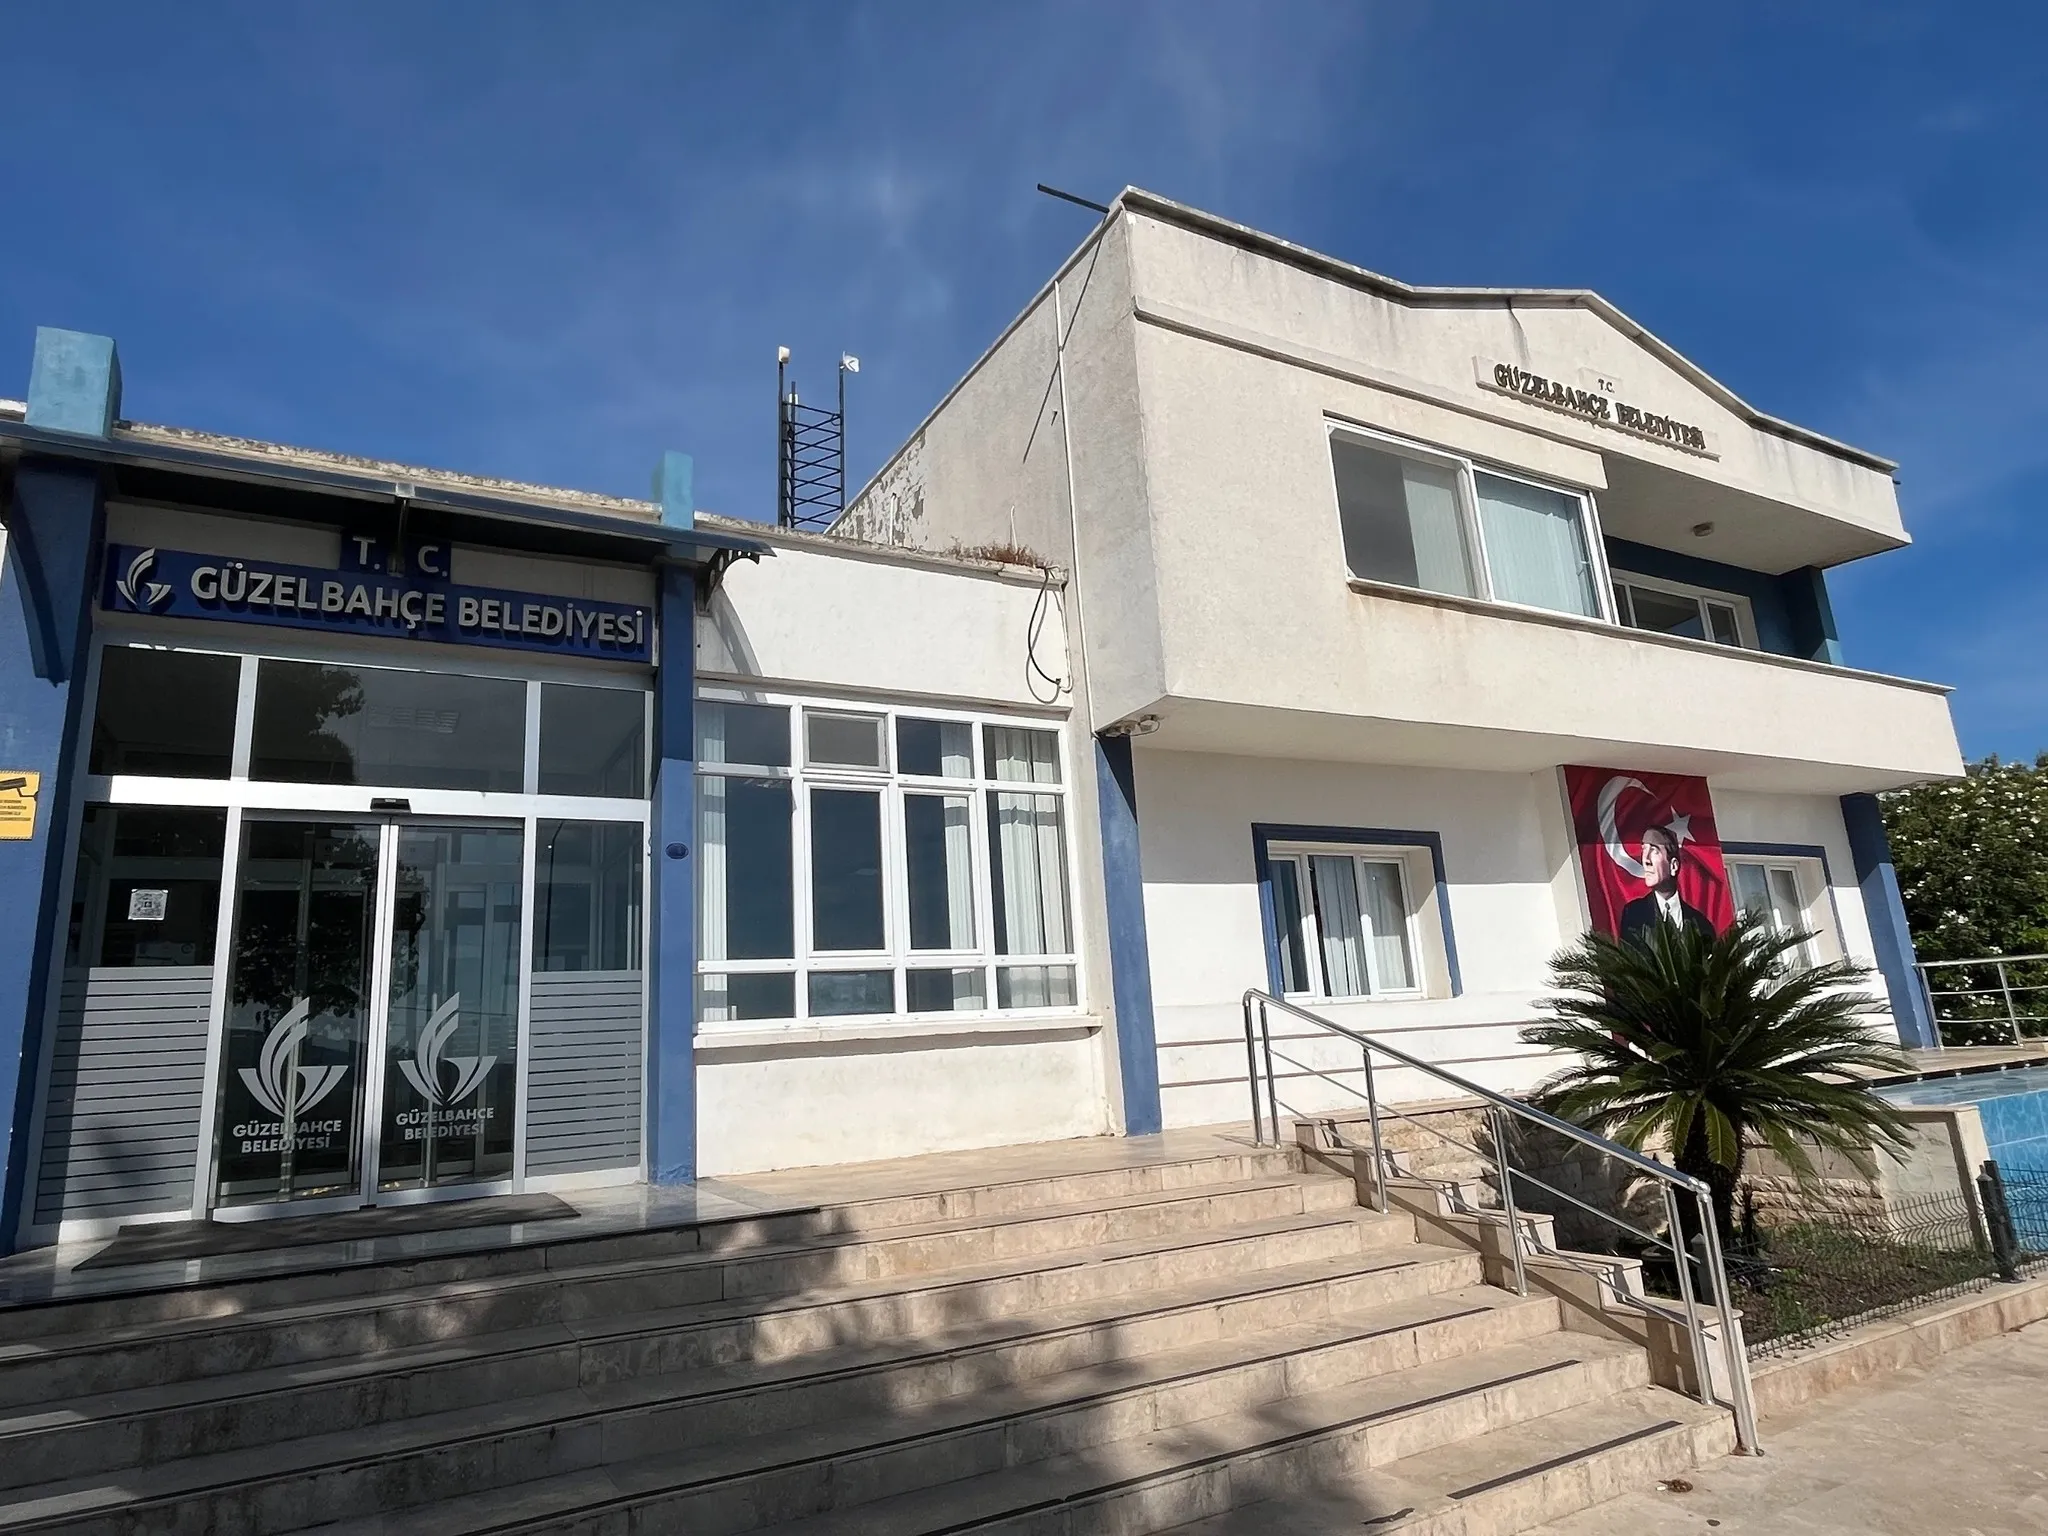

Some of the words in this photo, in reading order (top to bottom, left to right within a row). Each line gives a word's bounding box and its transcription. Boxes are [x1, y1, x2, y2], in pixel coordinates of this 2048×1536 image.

[191, 561, 445, 629] GÜZELBAHÇE
[458, 596, 644, 644] BELEDİYESİ
[404, 1119, 484, 1140] BELEDİYESİ
